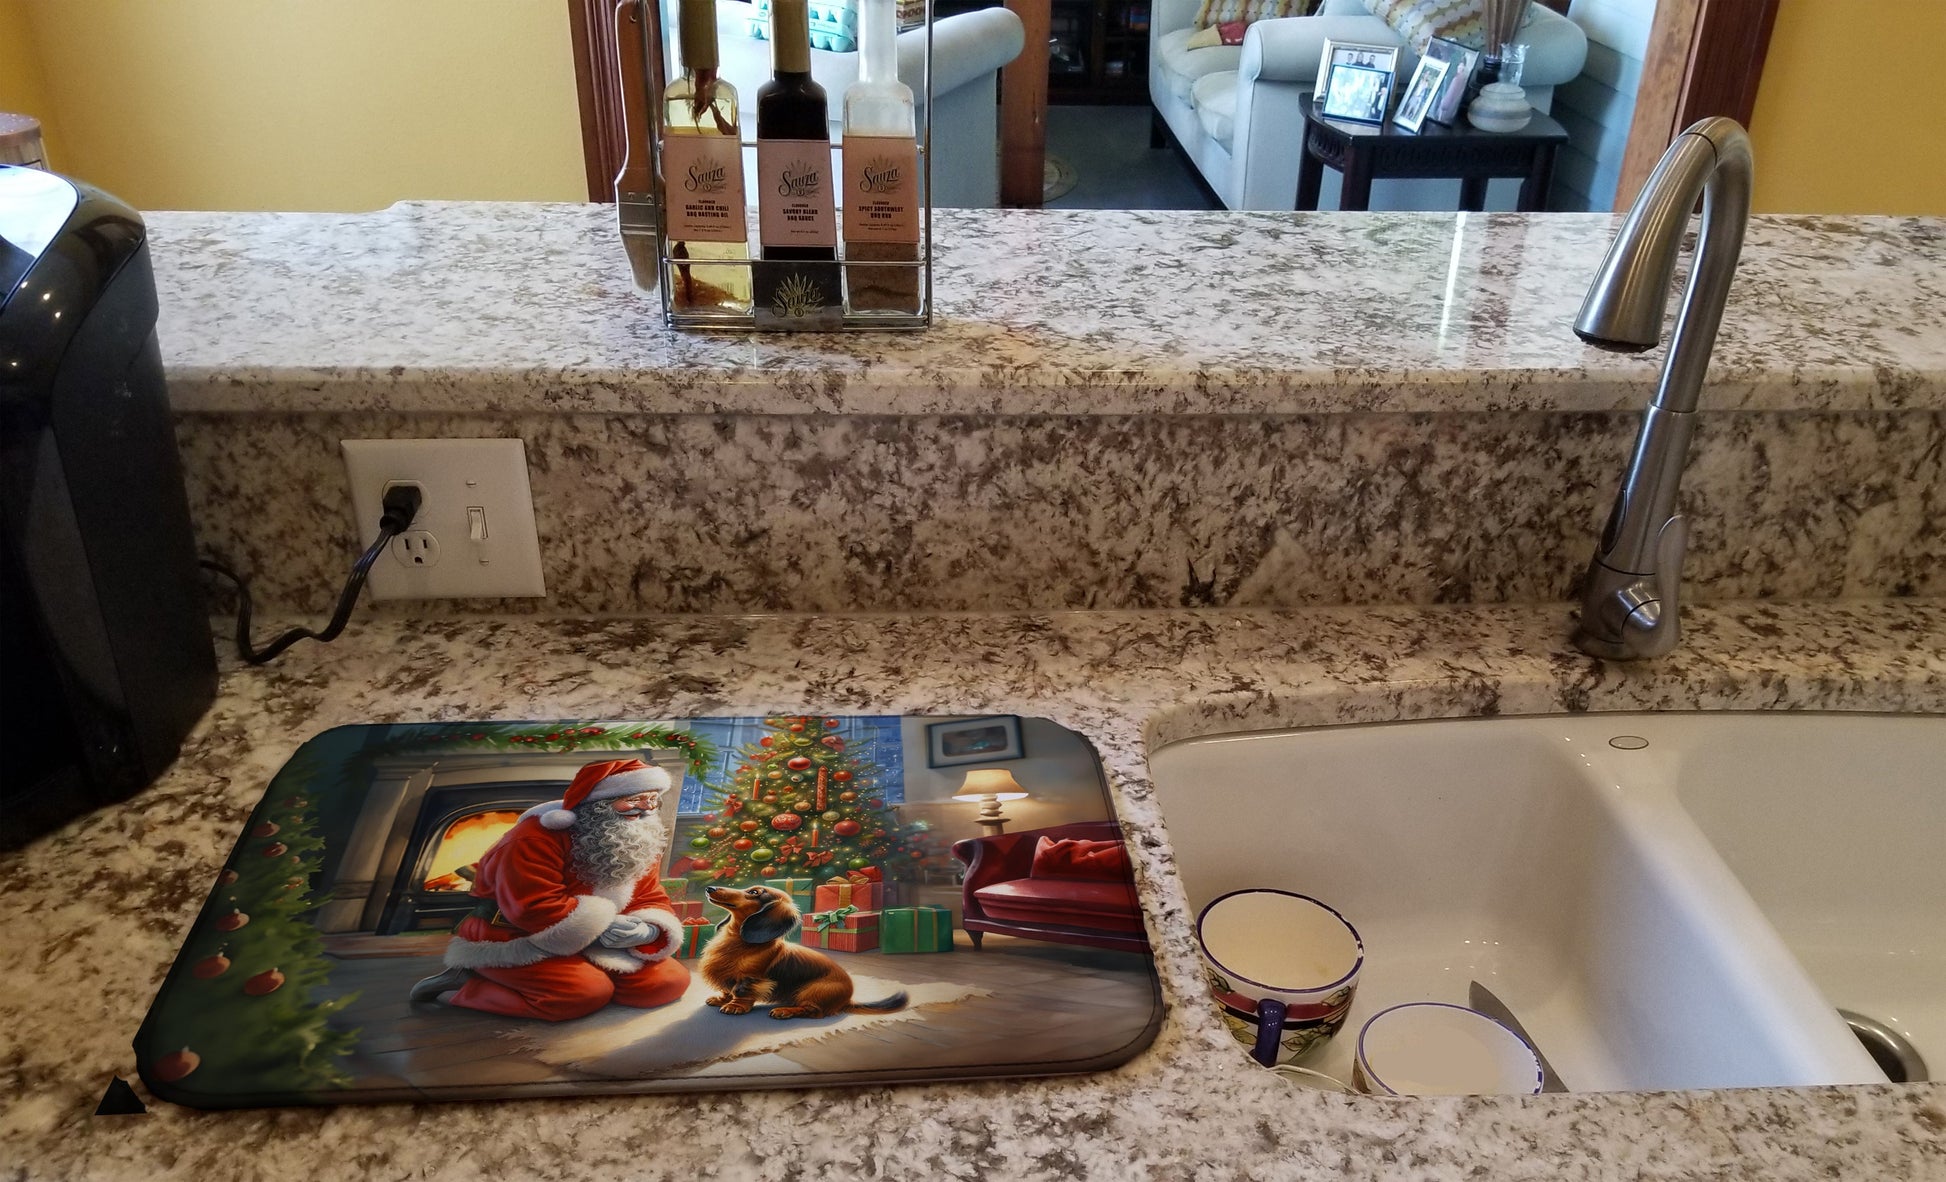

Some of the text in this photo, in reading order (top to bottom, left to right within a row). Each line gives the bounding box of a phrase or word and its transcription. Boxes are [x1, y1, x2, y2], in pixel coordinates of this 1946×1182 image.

[684, 165, 726, 192] Sauza
[778, 170, 819, 197] Sauza
[860, 166, 900, 192] Sauza
